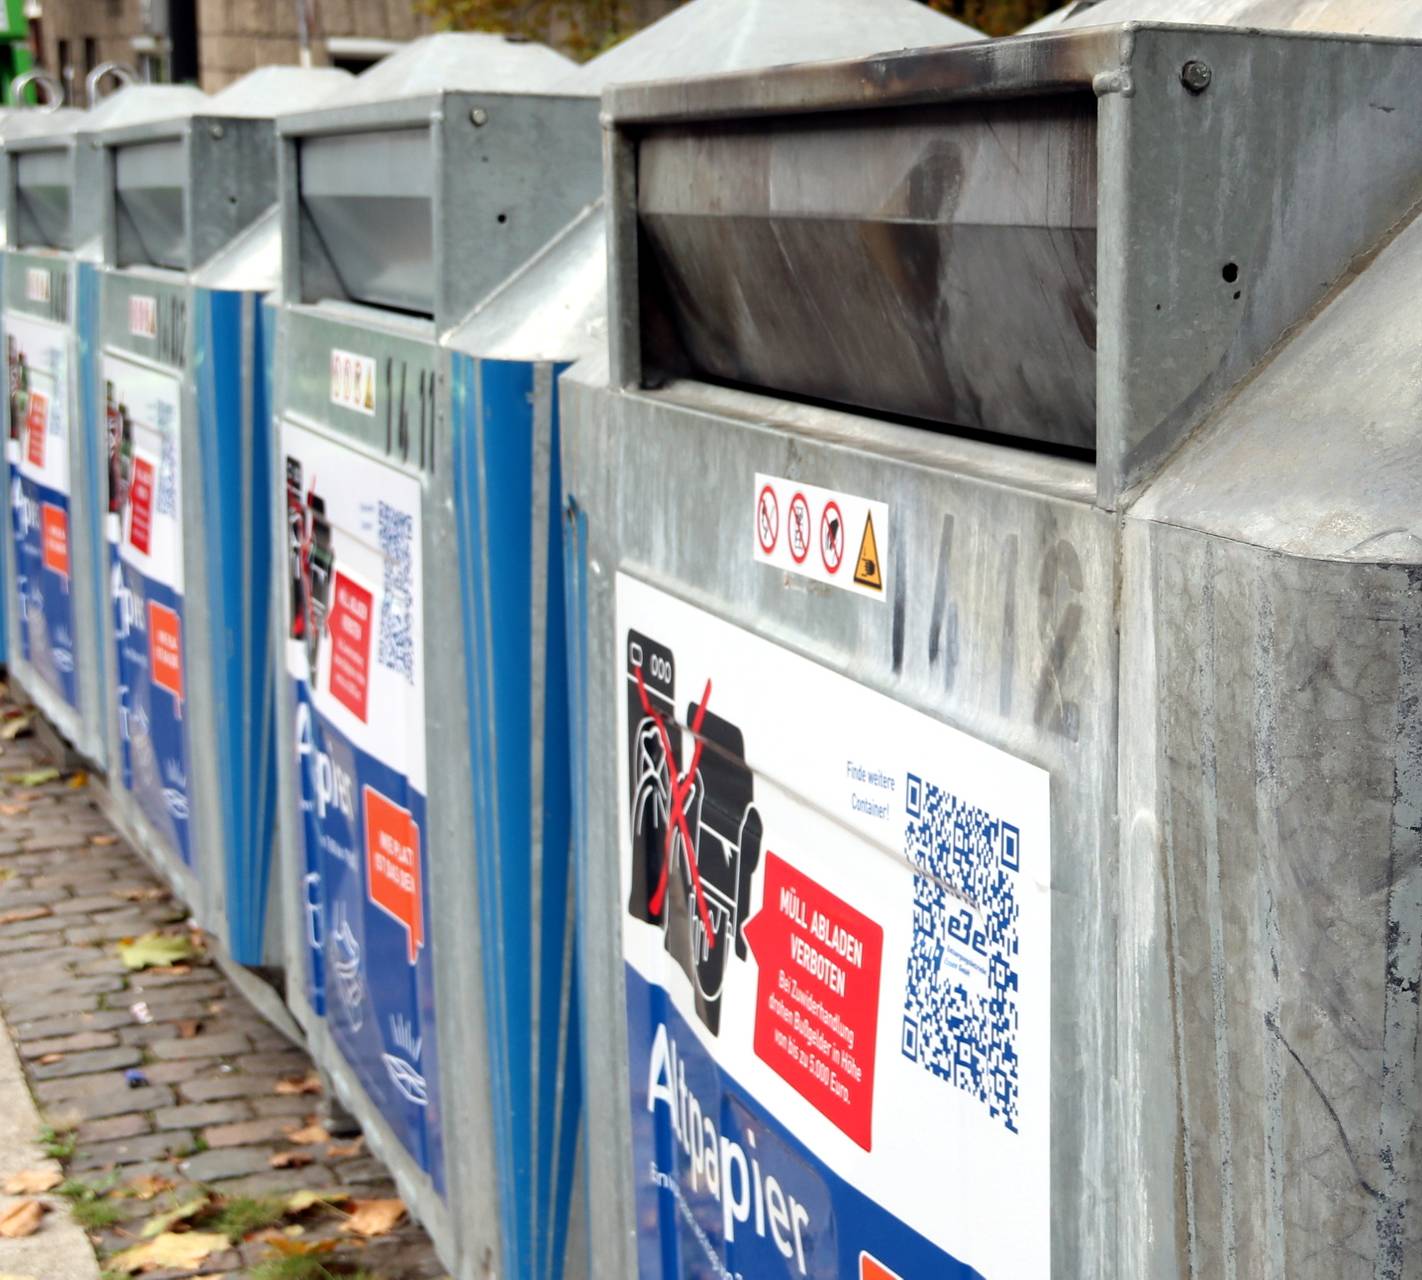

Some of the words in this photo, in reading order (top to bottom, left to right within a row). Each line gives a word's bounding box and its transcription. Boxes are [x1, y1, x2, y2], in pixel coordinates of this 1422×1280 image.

[846, 760, 866, 783] Finde
[867, 770, 896, 792] weitere
[851, 793, 890, 821] Container!
[779, 886, 808, 929] MÜLL
[810, 910, 863, 969] ABLADEN
[790, 932, 846, 997] VERBOTEN
[768, 994, 794, 1027] drohen
[793, 1011, 832, 1057] Bußgelder
[831, 1042, 841, 1064] in
[841, 1051, 863, 1083] Höhe
[778, 969, 791, 994] Bei
[790, 978, 855, 1049] Zuwiderhandlung
[773, 1029, 788, 1051] von
[787, 1033, 800, 1060] bis
[798, 1046, 809, 1068] zu
[808, 1051, 830, 1087] 5.000
[829, 1068, 851, 1104] Euro.
[647, 1022, 810, 1276] Altpapier
